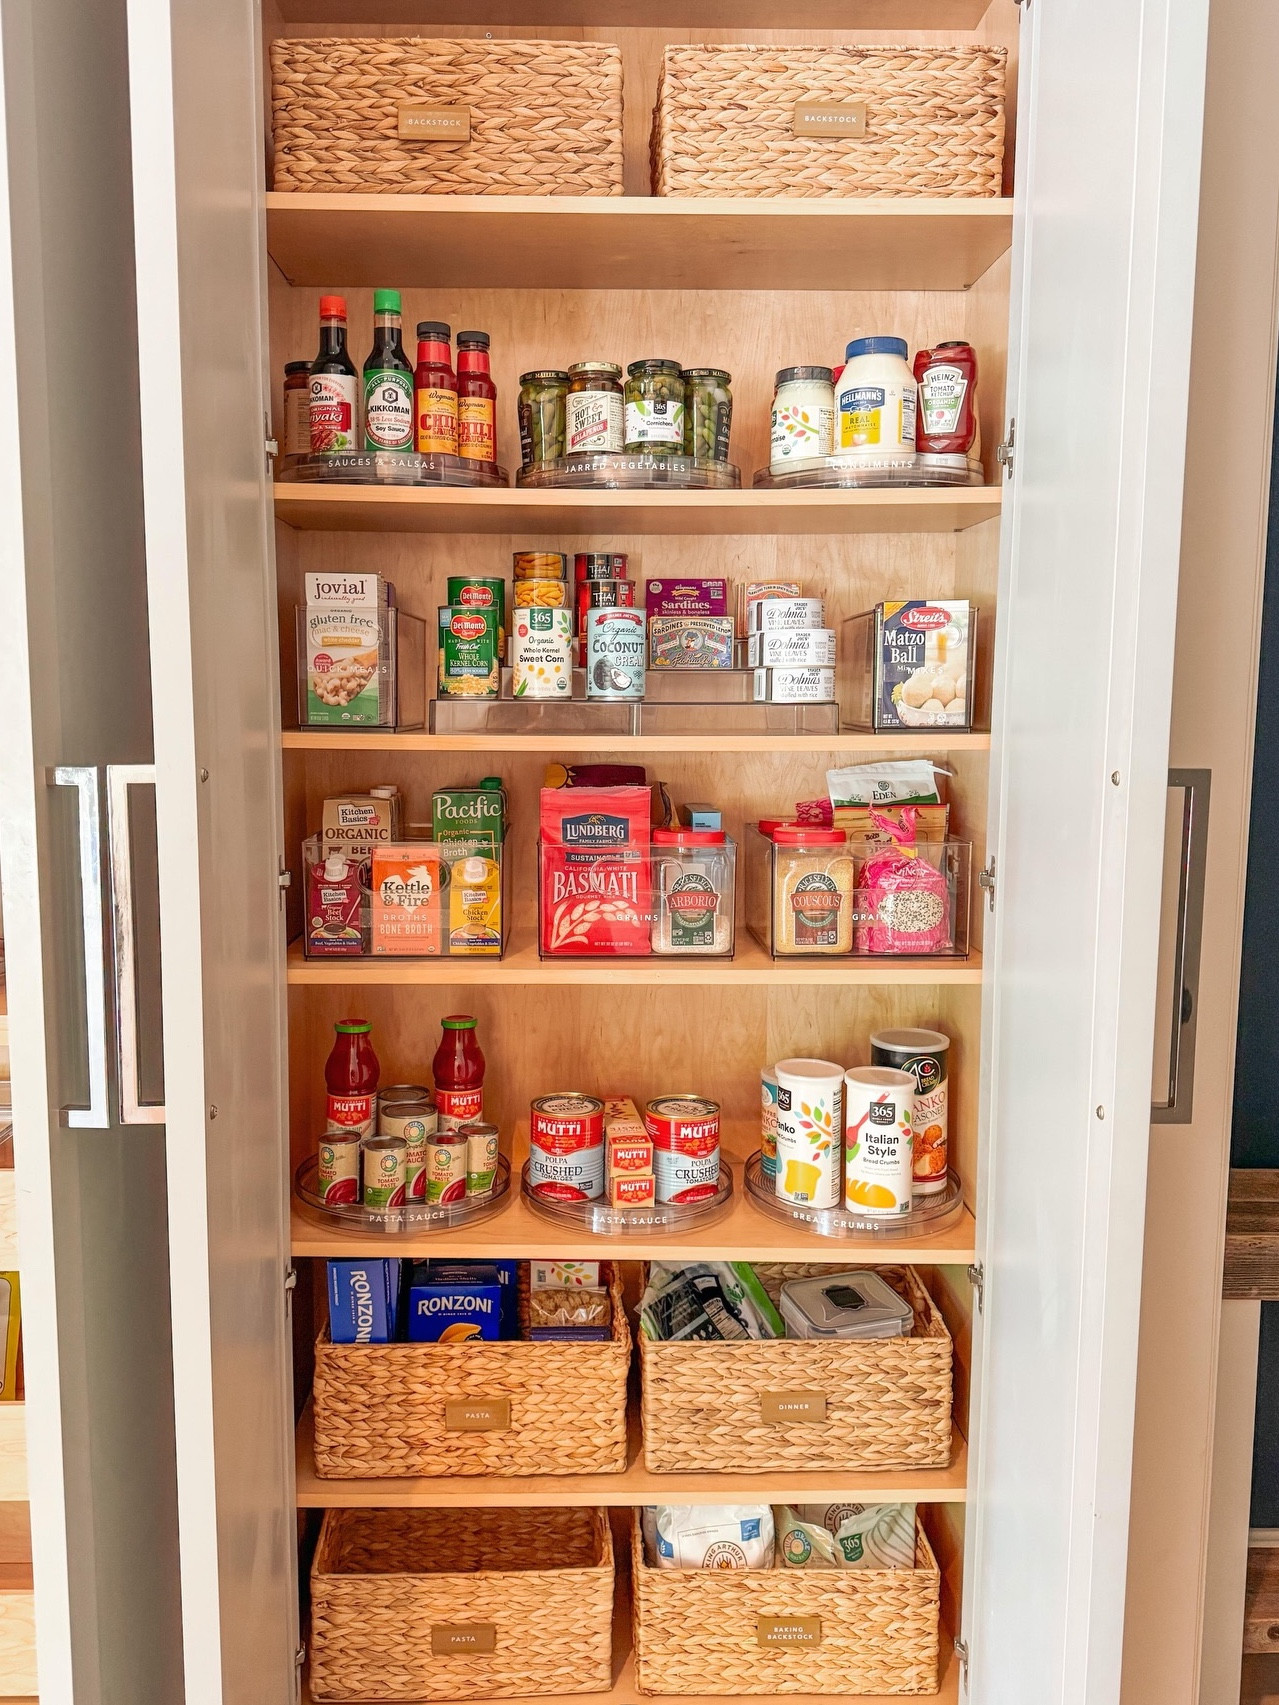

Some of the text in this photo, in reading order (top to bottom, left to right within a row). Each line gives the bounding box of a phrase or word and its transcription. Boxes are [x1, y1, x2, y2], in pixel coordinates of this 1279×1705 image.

[407, 118, 461, 128] BACKSTOCK
[804, 115, 857, 124] BACKSTOCK
[930, 373, 956, 383] HEINZ
[929, 385, 956, 393] TOMATO
[428, 391, 456, 402] Wegmans
[841, 390, 883, 406] HELLMANN'S
[370, 405, 410, 415] KIKKOMAN
[575, 406, 591, 422] HOT
[575, 411, 603, 433] SWEET
[849, 416, 870, 424] REAL
[328, 458, 436, 470] SAUCES & SALSAS
[564, 462, 686, 474] JARRED VEGETABLES
[589, 566, 611, 575] THAI
[314, 578, 366, 600] jovial
[473, 592, 492, 600] Monte
[593, 593, 616, 602] THAI
[662, 601, 711, 610] Sardines
[532, 612, 551, 624] 365
[767, 607, 807, 620] Dolmas
[903, 611, 948, 625] Streit's
[310, 614, 374, 629] gluten free
[464, 622, 485, 630] Monte
[315, 627, 332, 635] mac
[340, 626, 371, 637] cheese
[603, 621, 637, 642] Organic
[654, 623, 684, 635] SARDINES
[528, 636, 555, 646] Organic
[884, 630, 925, 646] Matzo
[593, 639, 644, 653] COCONUT
[768, 638, 810, 651] Dolmas
[519, 655, 565, 663] Sweet Corn
[614, 655, 644, 667] CREAM
[891, 646, 917, 664] Ball
[472, 659, 489, 667] CORN
[307, 666, 387, 674] QUICK MEALS
[778, 673, 821, 686] Dolmas
[872, 790, 898, 801] EDEN
[341, 808, 374, 816] Kitchen
[432, 796, 502, 820] Pacific
[342, 816, 369, 824] Basics
[325, 828, 389, 840] ORGANIC
[443, 829, 470, 838] Organic
[566, 824, 625, 840] LUNDBERG
[443, 838, 478, 847] Chicken
[443, 847, 468, 857] Broth
[383, 880, 430, 895] Kettle
[553, 872, 638, 905] BASMATI
[384, 895, 430, 908] & Fire
[670, 896, 717, 908] ARBORIO
[793, 896, 841, 908] COUSCOUS
[328, 908, 342, 916] Beef
[463, 909, 489, 917] Chicken
[380, 924, 433, 936] BONE BROTH
[334, 1102, 366, 1112] MUTTI
[451, 1096, 481, 1107] MUTTI
[913, 1091, 946, 1113] ANKO
[872, 1106, 893, 1118] 365
[538, 1122, 581, 1136] MUTTI
[680, 1122, 719, 1139] MUTTI
[777, 1119, 796, 1134] anko
[865, 1133, 900, 1145] Italian
[617, 1150, 648, 1159] MUTTI
[868, 1146, 897, 1158] Style
[545, 1156, 568, 1165] POLPA
[691, 1158, 712, 1167] POLPA
[863, 1157, 879, 1165] Bread
[534, 1162, 583, 1177] CRUSHED
[621, 1182, 650, 1192] MUTTI
[369, 1211, 446, 1223] PASTA SAUCE
[592, 1216, 668, 1225] PASTA SAUCE
[793, 1211, 880, 1231] BREAD CRUMBS
[350, 1271, 373, 1343] RONZONI
[417, 1296, 492, 1316] RONZONI
[828, 1506, 840, 1520] KING
[843, 1537, 860, 1553] 365
[706, 1544, 743, 1568] KING ARTHUR
[767, 1633, 814, 1641] BACKSTOCK
